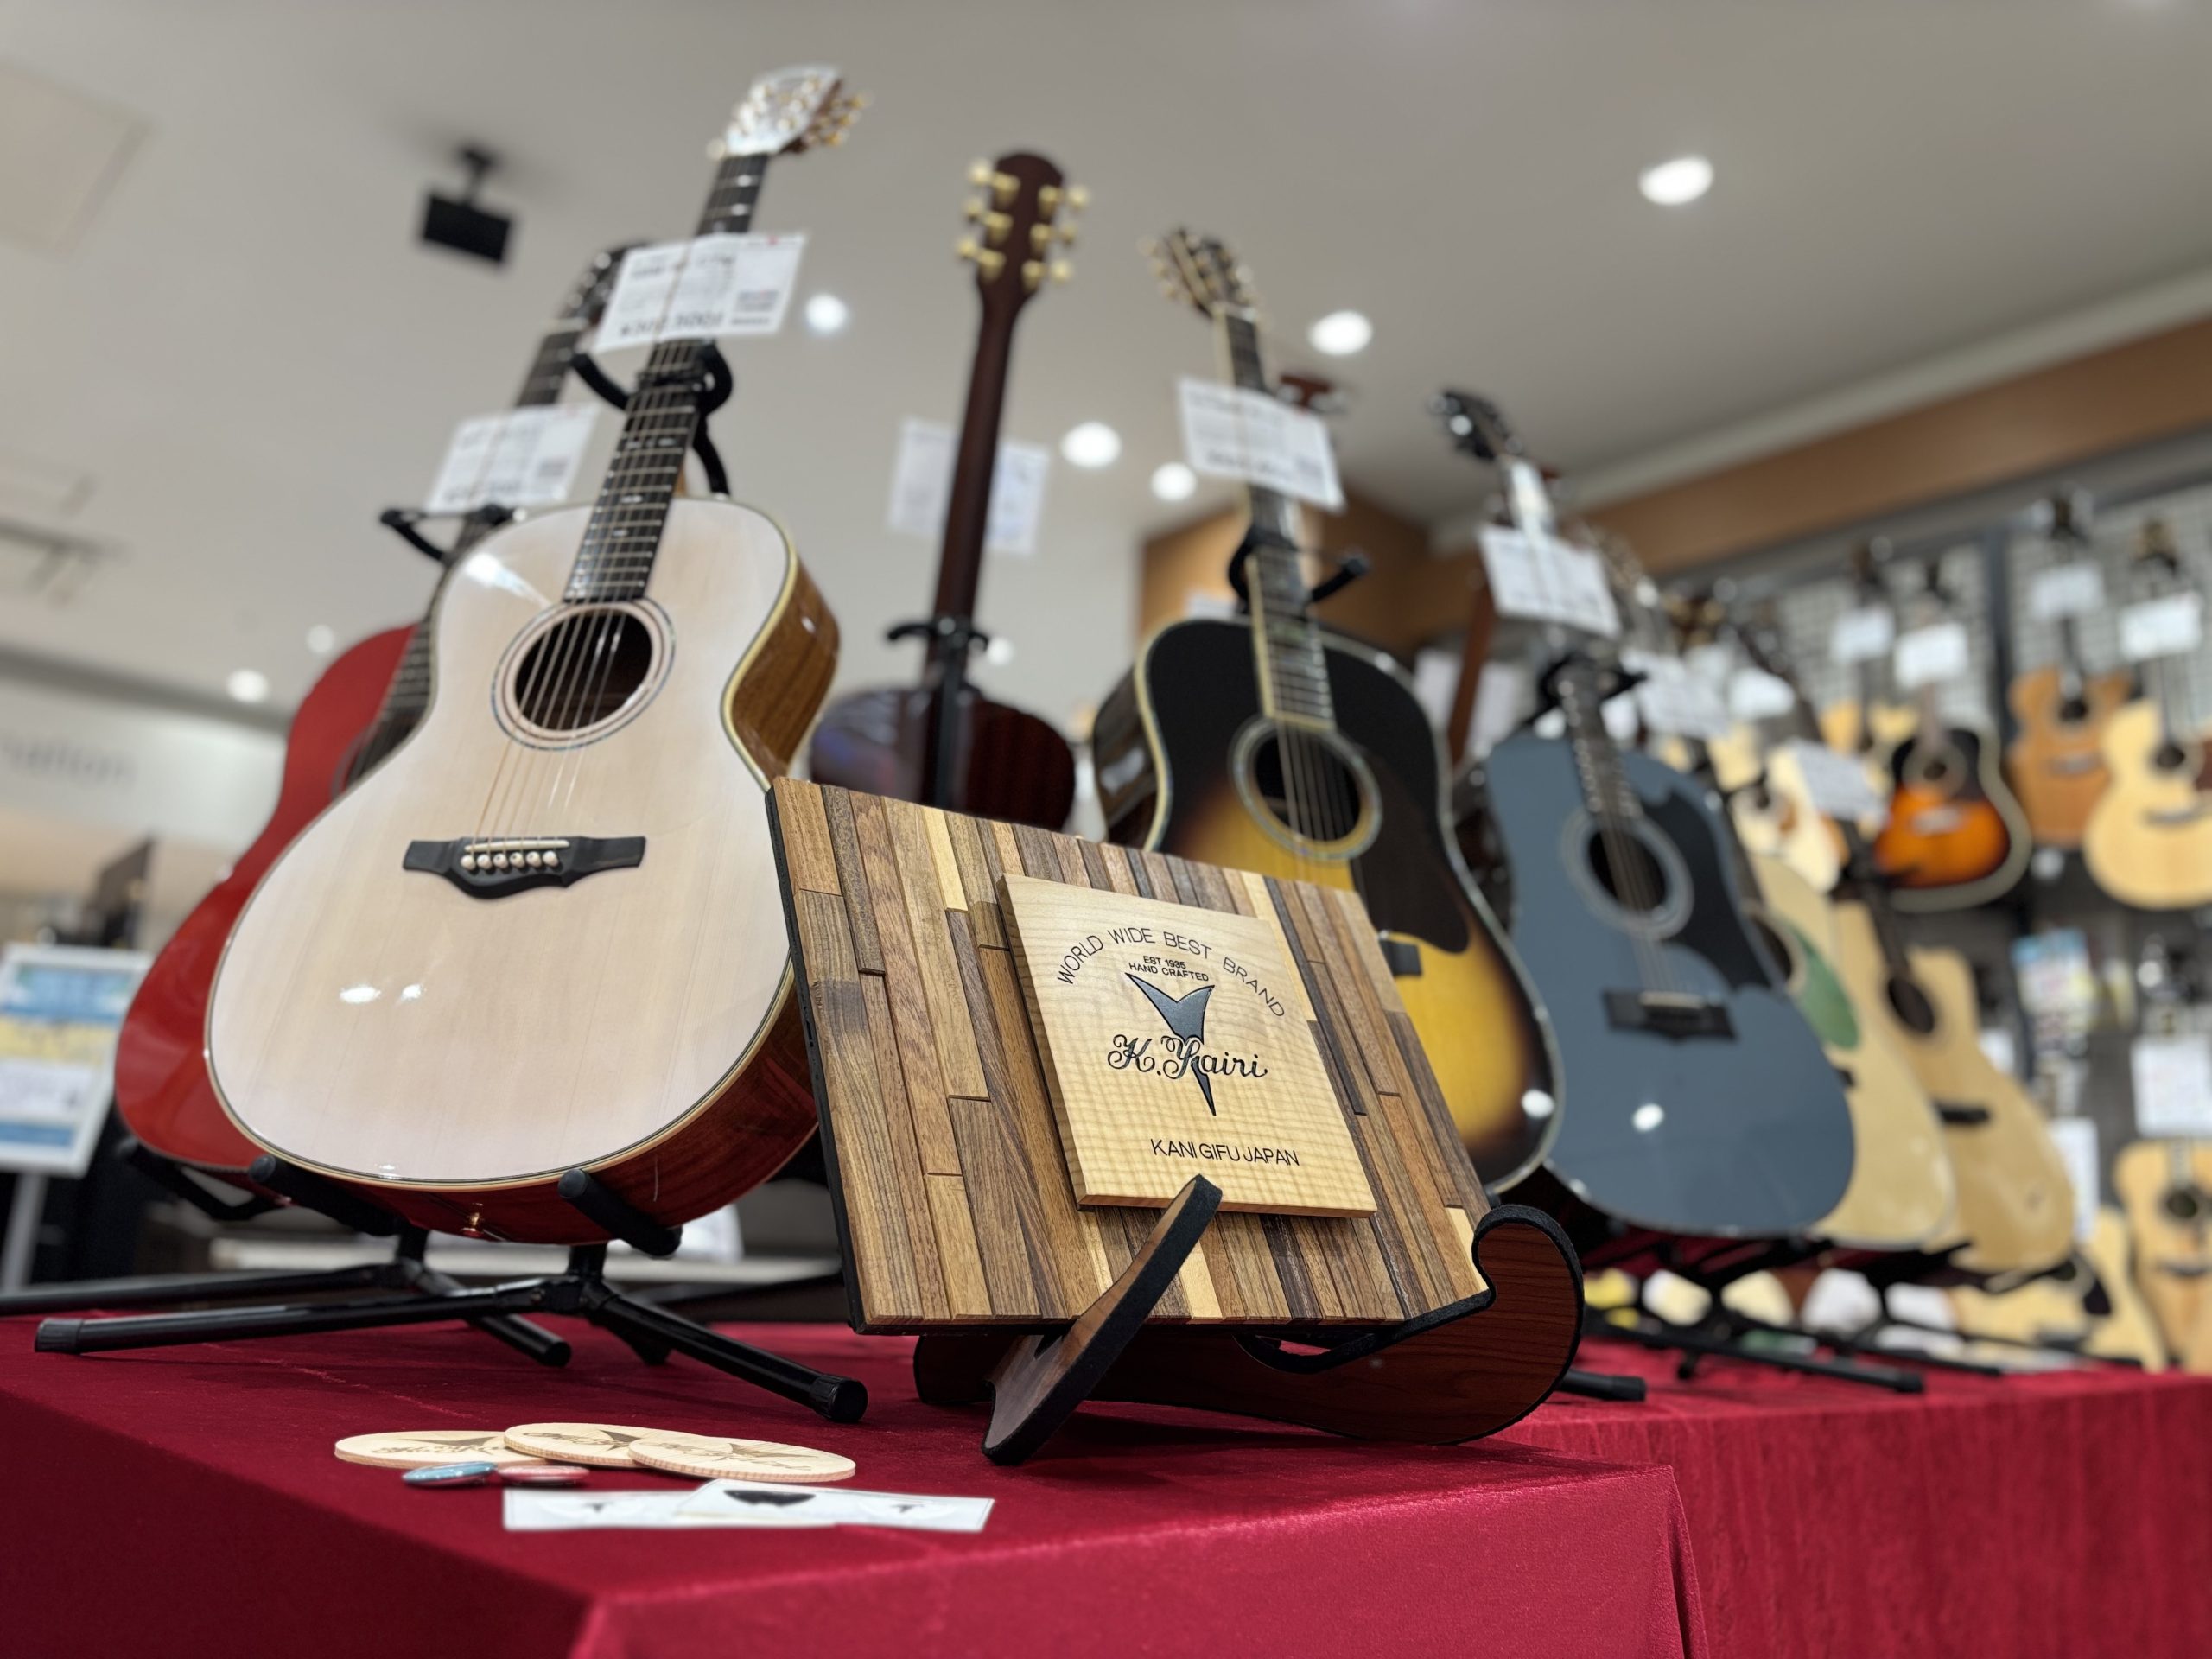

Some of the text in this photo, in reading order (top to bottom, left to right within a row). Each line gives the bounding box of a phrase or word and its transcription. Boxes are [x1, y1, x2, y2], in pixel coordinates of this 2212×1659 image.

[1057, 927, 1285, 1019] WORLD WIDE BEST BRAND
[1128, 962, 1209, 982] HAND CRAFTED
[1142, 955, 1186, 969] EST 1935
[1150, 1138, 1300, 1166] KANI GIFU JAPAN
